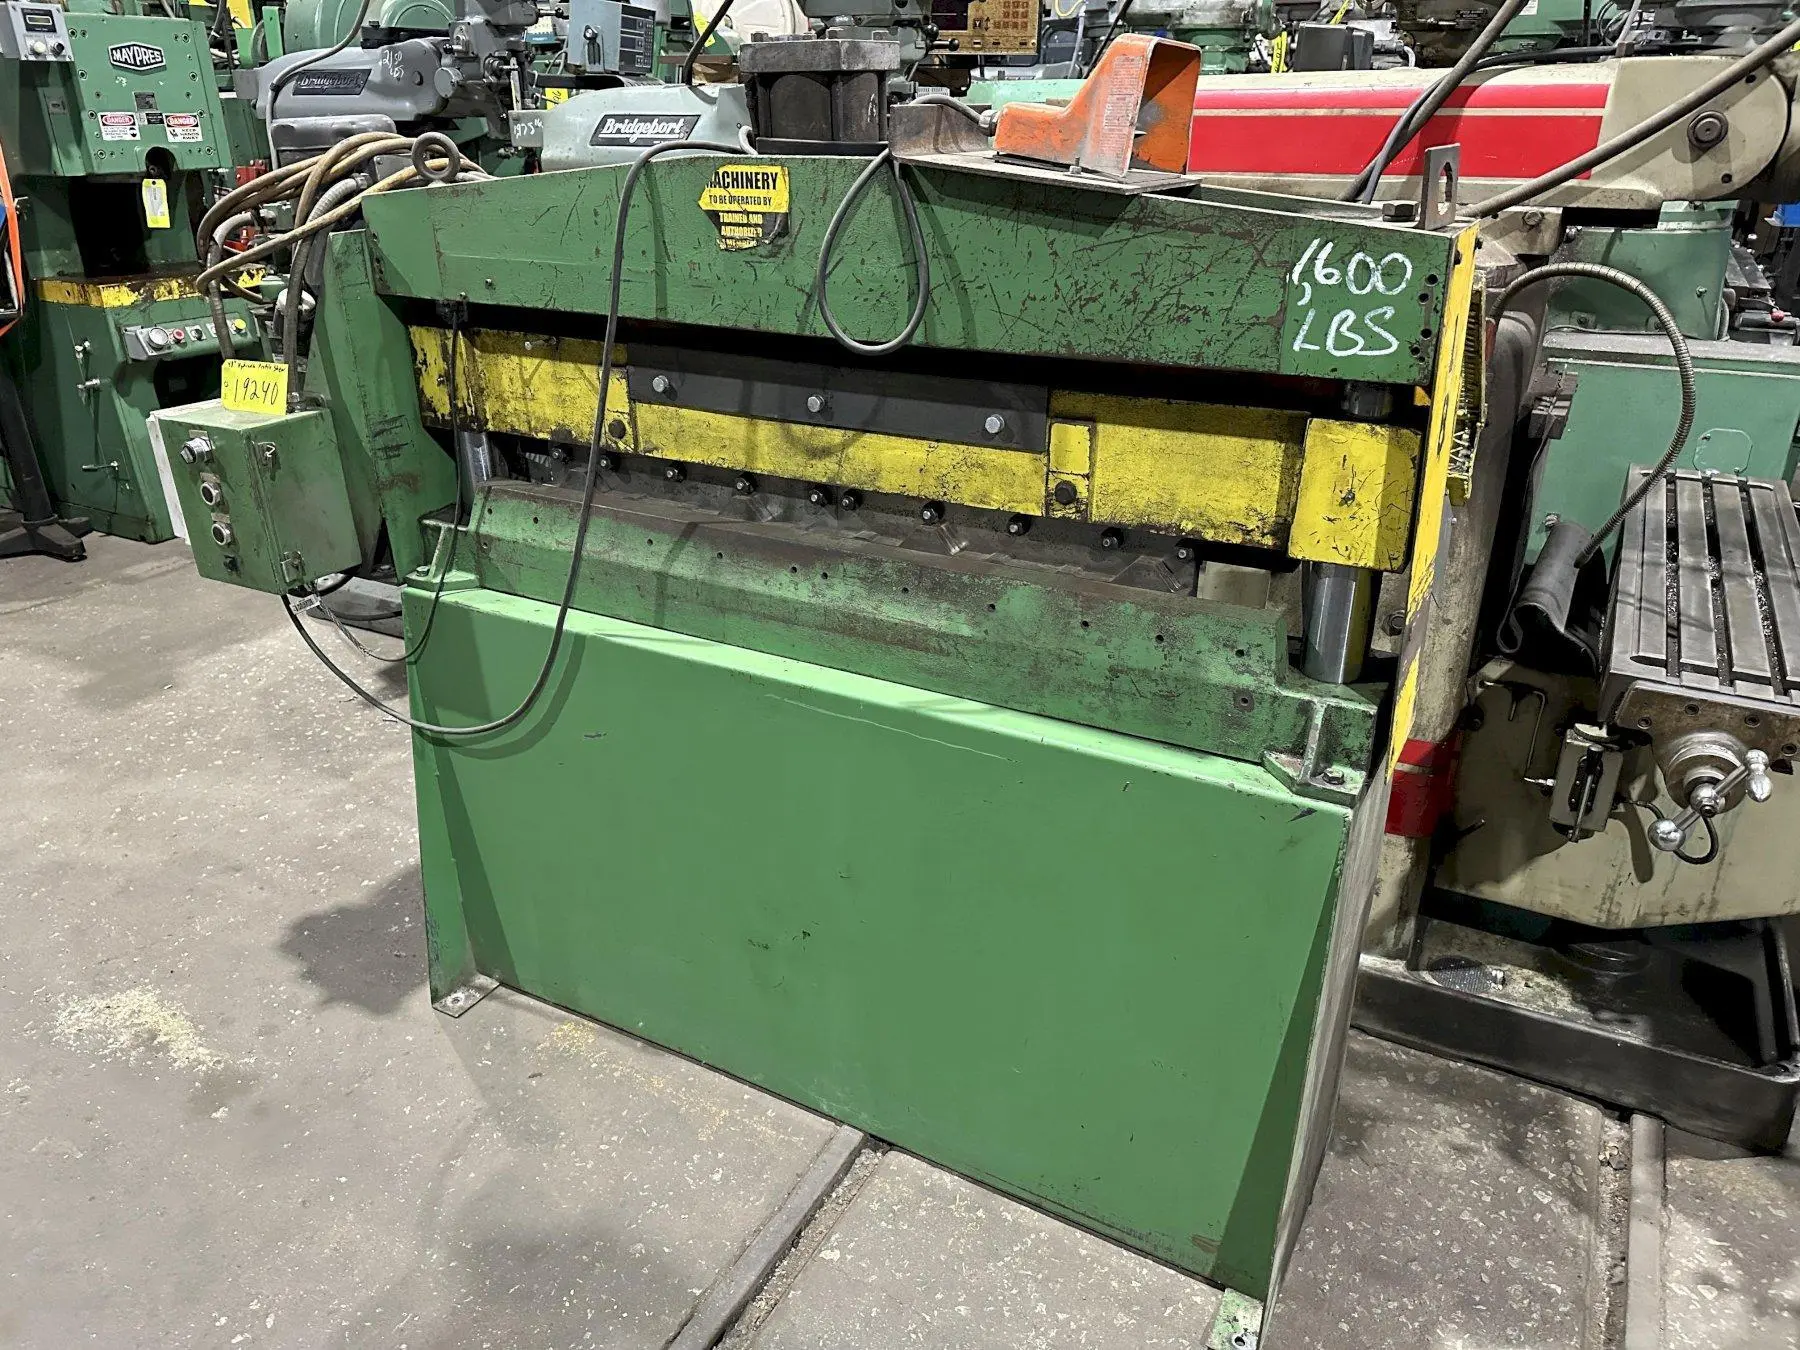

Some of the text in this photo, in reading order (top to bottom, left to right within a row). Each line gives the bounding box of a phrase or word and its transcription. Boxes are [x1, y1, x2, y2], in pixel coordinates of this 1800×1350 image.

[112, 46, 162, 66] MAYPRES
[598, 117, 685, 143] Bridgeport
[709, 194, 772, 206] TO BE OPERATED BY
[719, 212, 763, 224] TRAINED AND
[1291, 238, 1414, 306] 1,600
[1292, 305, 1400, 357] LBS
[234, 377, 279, 405] 19240
